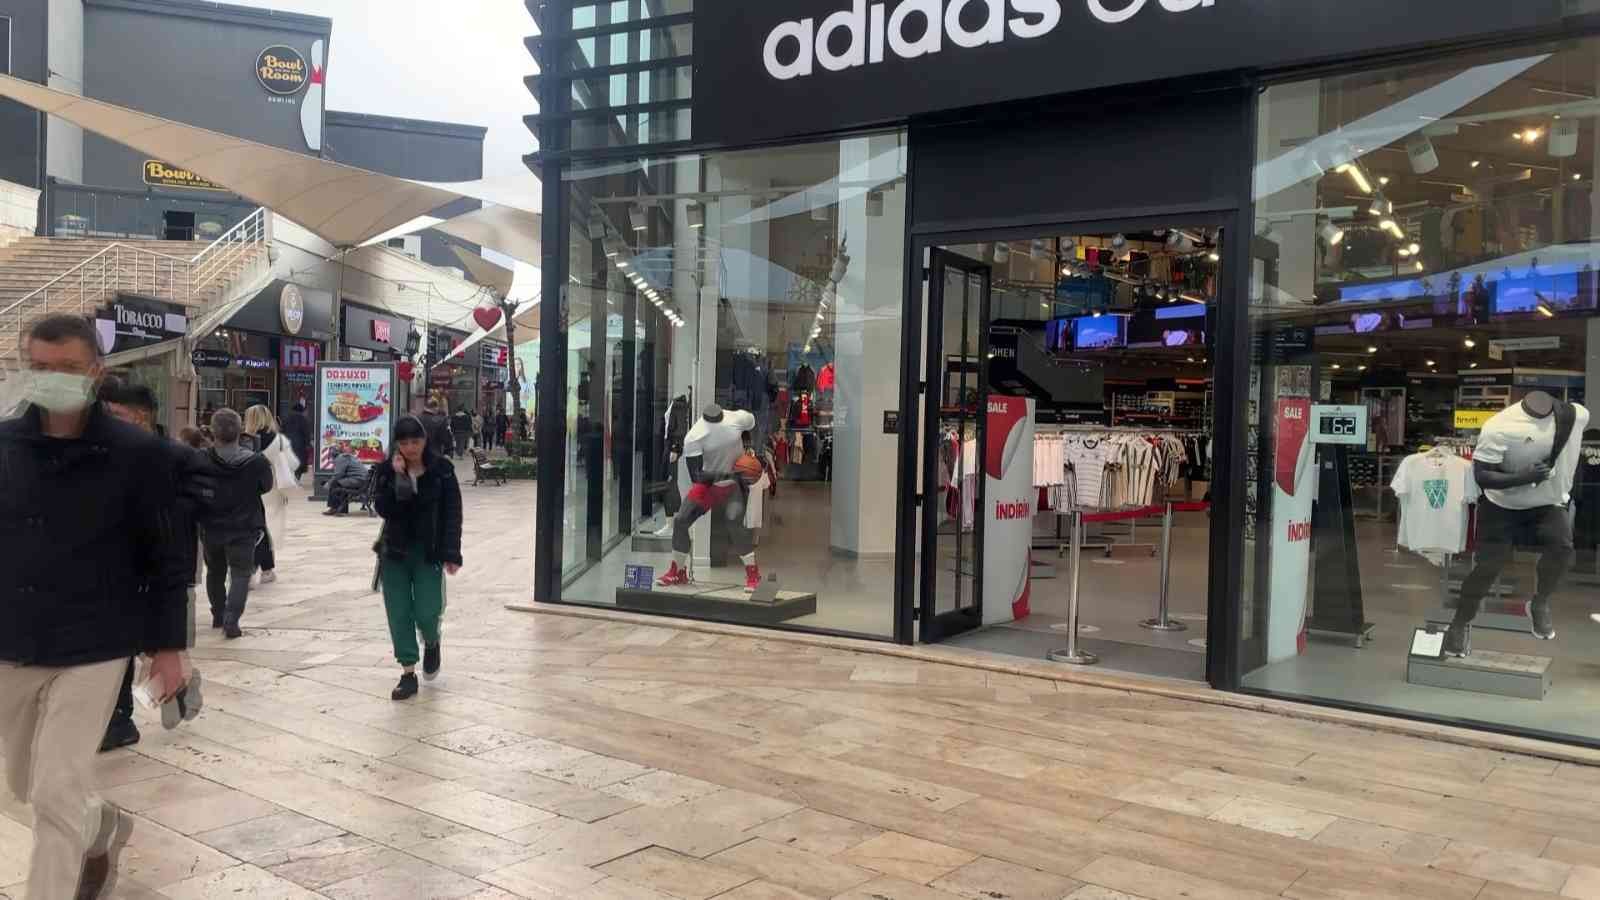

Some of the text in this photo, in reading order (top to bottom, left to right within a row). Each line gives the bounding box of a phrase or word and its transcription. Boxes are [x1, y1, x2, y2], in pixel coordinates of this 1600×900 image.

[763, 0, 1061, 80] adidas
[264, 55, 303, 70] Bowl
[260, 67, 303, 82] Room
[114, 304, 162, 329] TOBACCO
[987, 402, 1008, 413] SALE
[1284, 406, 1303, 419] SALE
